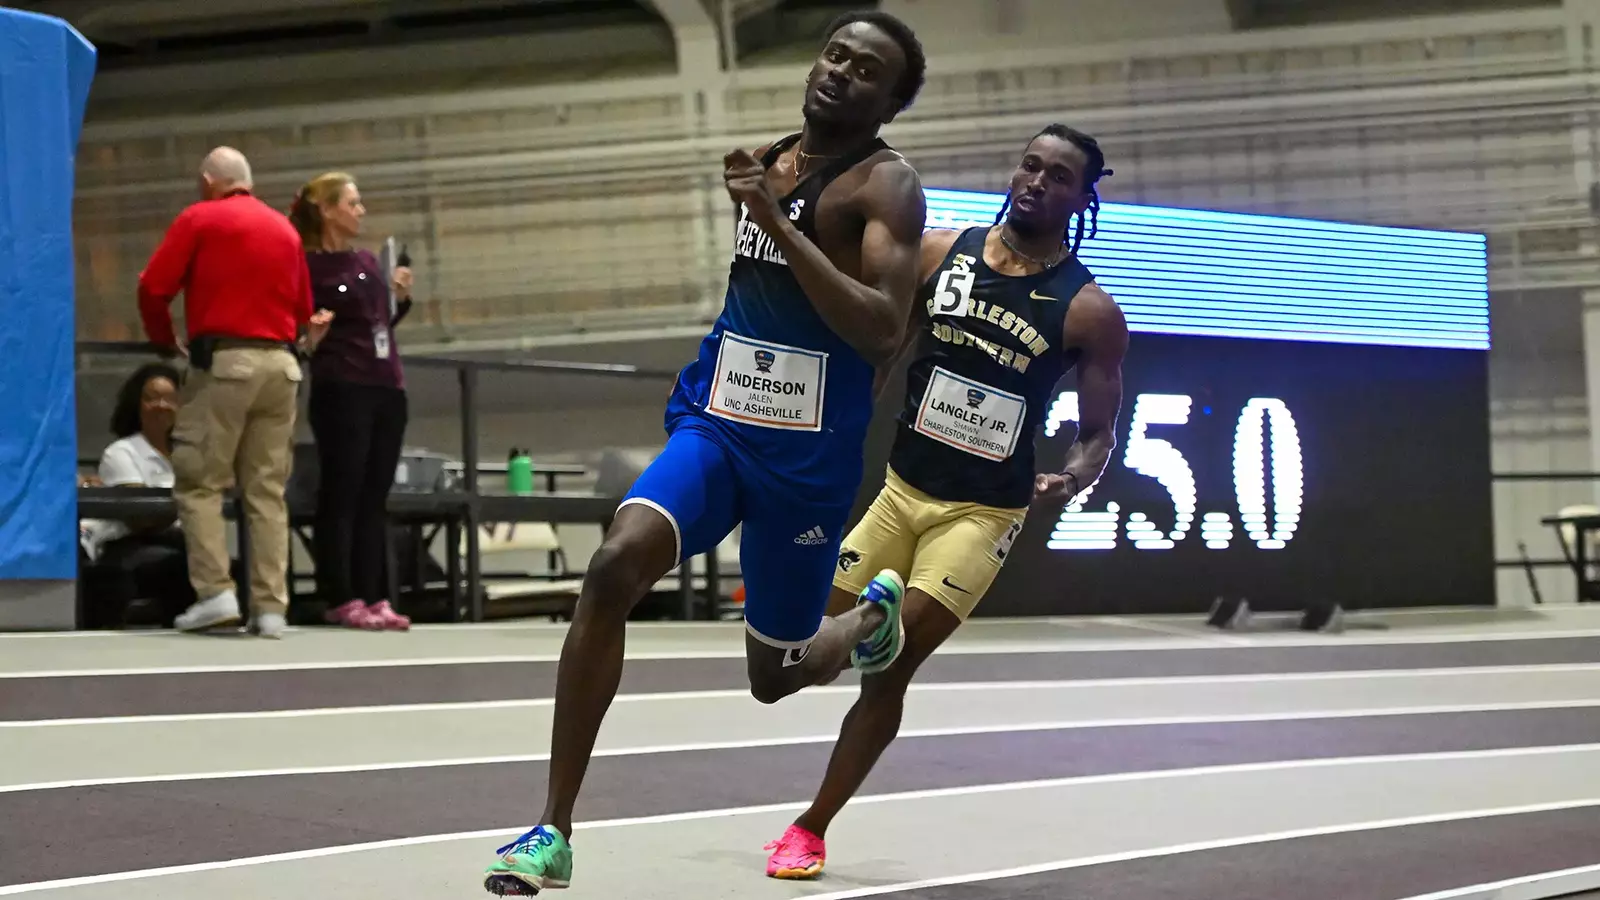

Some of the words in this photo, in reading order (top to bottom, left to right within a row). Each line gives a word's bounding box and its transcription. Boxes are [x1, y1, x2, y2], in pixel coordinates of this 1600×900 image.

[940, 273, 966, 313] 5
[926, 298, 1050, 357] CRLESTON
[726, 370, 806, 396] ANDERSON
[747, 392, 773, 404] JALEN
[724, 397, 741, 410] UNC
[743, 402, 803, 420] ASHEVILLE
[930, 398, 988, 427] LANGLEY
[989, 419, 1009, 434] JR.
[923, 418, 967, 441] CHARLESTON
[967, 435, 1006, 453] SOUTHERN
[953, 420, 980, 435] SHAWN
[1045, 391, 1304, 550] 25.0
[793, 537, 828, 546] adidas
